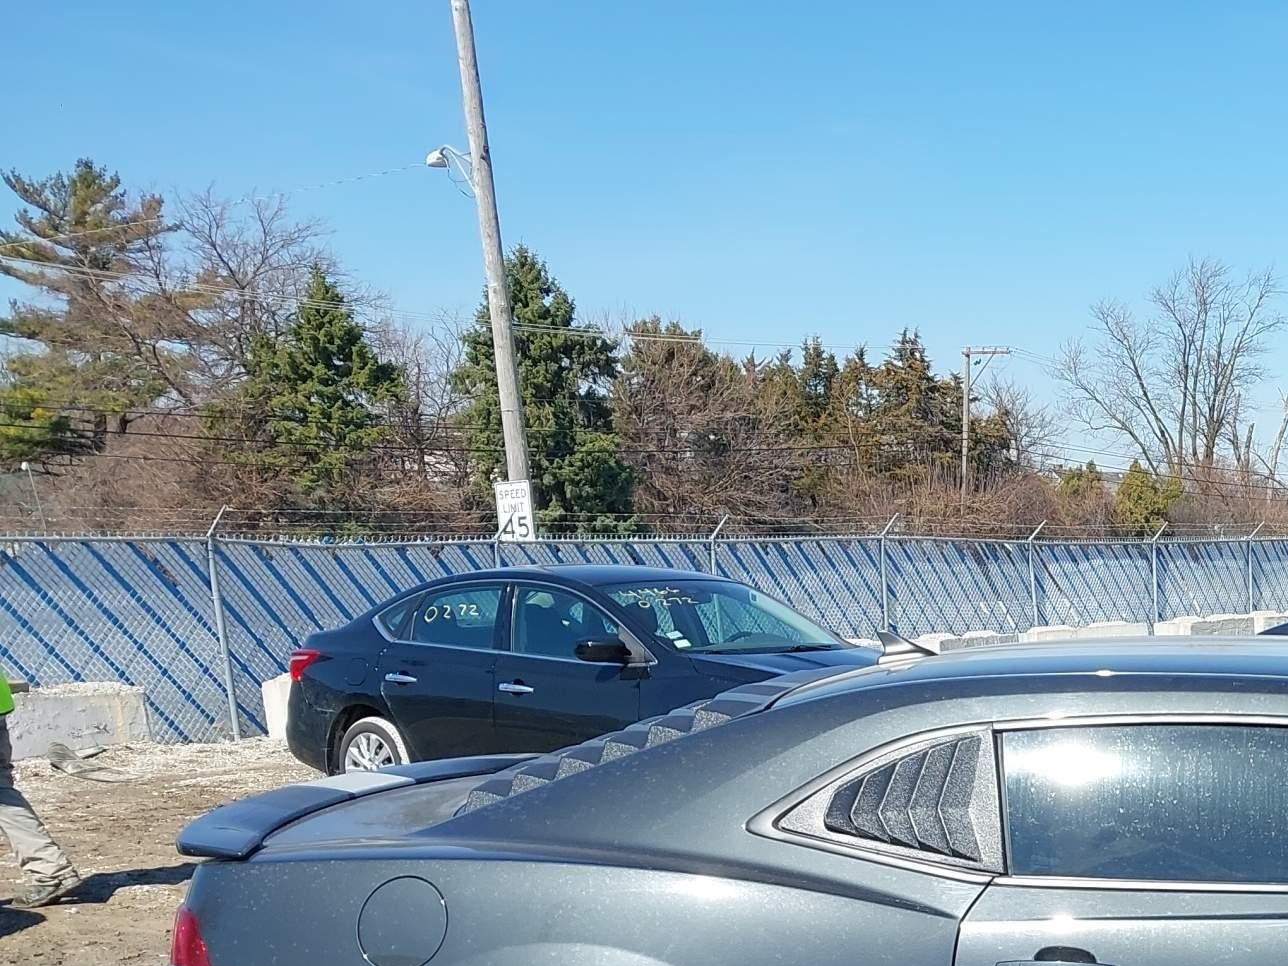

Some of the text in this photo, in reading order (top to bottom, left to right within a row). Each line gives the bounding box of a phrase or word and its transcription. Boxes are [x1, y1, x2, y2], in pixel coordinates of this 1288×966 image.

[498, 488, 527, 500] SPEED
[502, 502, 524, 513] LIMIT
[503, 516, 530, 538] 45
[424, 604, 480, 623] 0272
